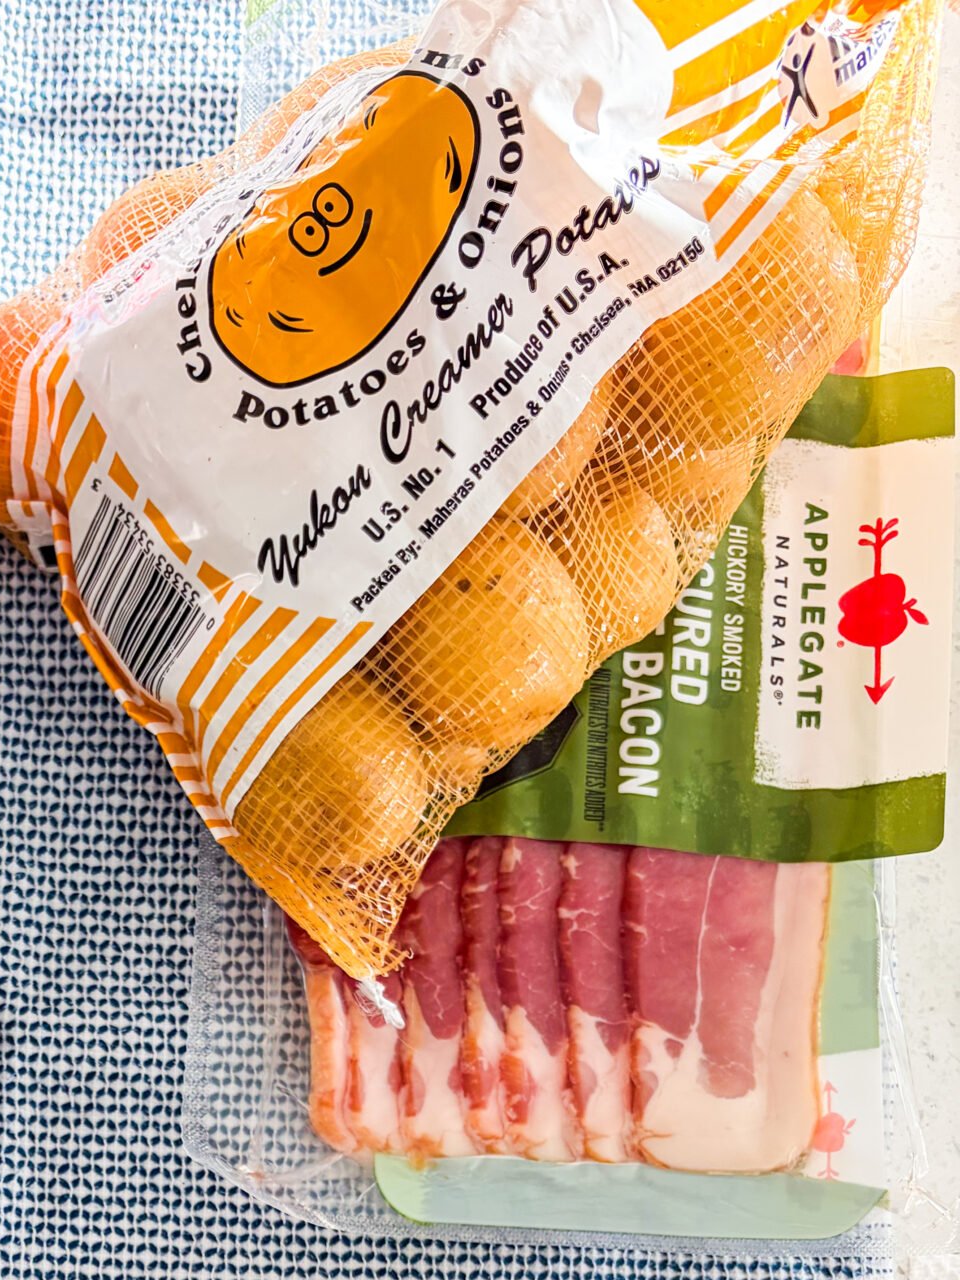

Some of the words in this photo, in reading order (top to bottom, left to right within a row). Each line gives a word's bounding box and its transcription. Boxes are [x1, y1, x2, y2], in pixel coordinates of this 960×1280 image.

[232, 328, 426, 430] Potatoes
[430, 282, 468, 321] &
[457, 87, 526, 269] Onions
[257, 464, 372, 588] Yukon
[380, 293, 514, 465] Creamer
[510, 155, 661, 293] Potates
[350, 558, 402, 613] Packed
[418, 476, 476, 540] Maheras
[469, 413, 530, 480] Potatoes
[525, 399, 544, 418] &
[537, 359, 572, 403] Onions
[626, 273, 661, 299] MA
[655, 235, 706, 283] 02150
[360, 500, 410, 543] U.S.
[400, 465, 442, 501] No.
[435, 438, 457, 460] 1
[469, 333, 544, 420] Produce
[537, 304, 561, 340] of
[554, 251, 630, 316] U.S.A.
[670, 553, 717, 707] CURED
[720, 613, 745, 693] SMOKED
[724, 523, 749, 607] HICKORY
[795, 501, 830, 730] APPLEGATE
[617, 650, 665, 798] BACON
